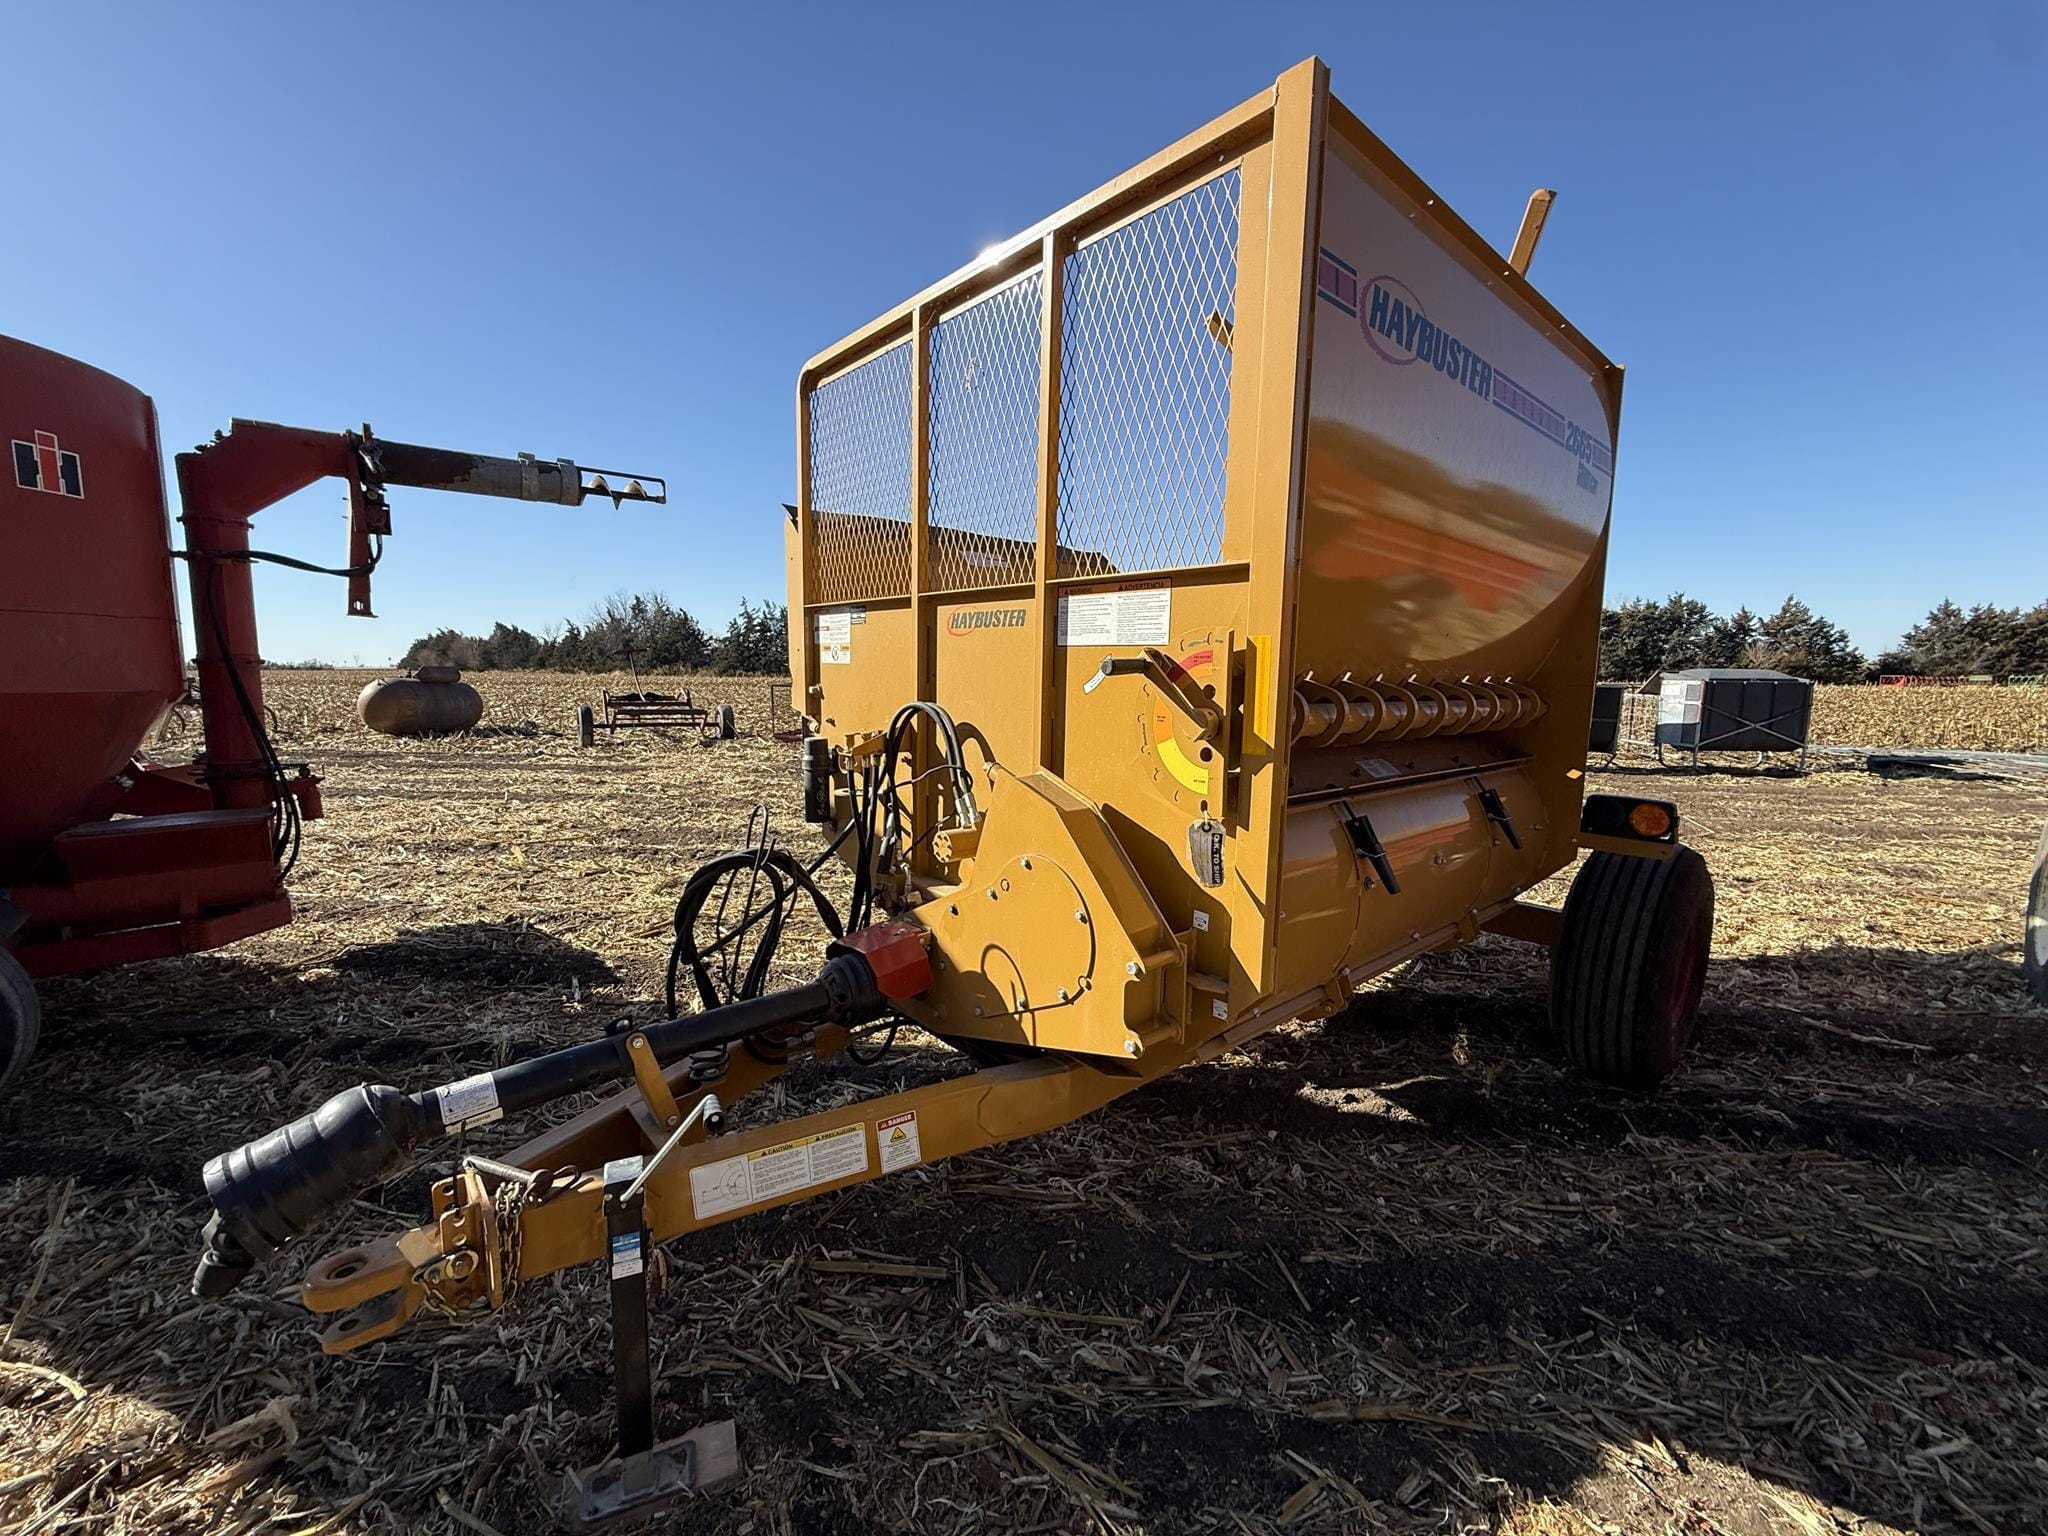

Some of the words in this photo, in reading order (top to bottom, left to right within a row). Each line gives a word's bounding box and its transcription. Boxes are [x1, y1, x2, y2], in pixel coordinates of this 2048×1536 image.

[1369, 283, 1493, 402] HAYBUSTER
[1565, 420, 1593, 465] 2665
[950, 609, 1027, 629] HAYBUSTER
[1213, 853, 1221, 865] TO
[887, 1114, 912, 1127] DANGER
[767, 1144, 793, 1155] CAUTION
